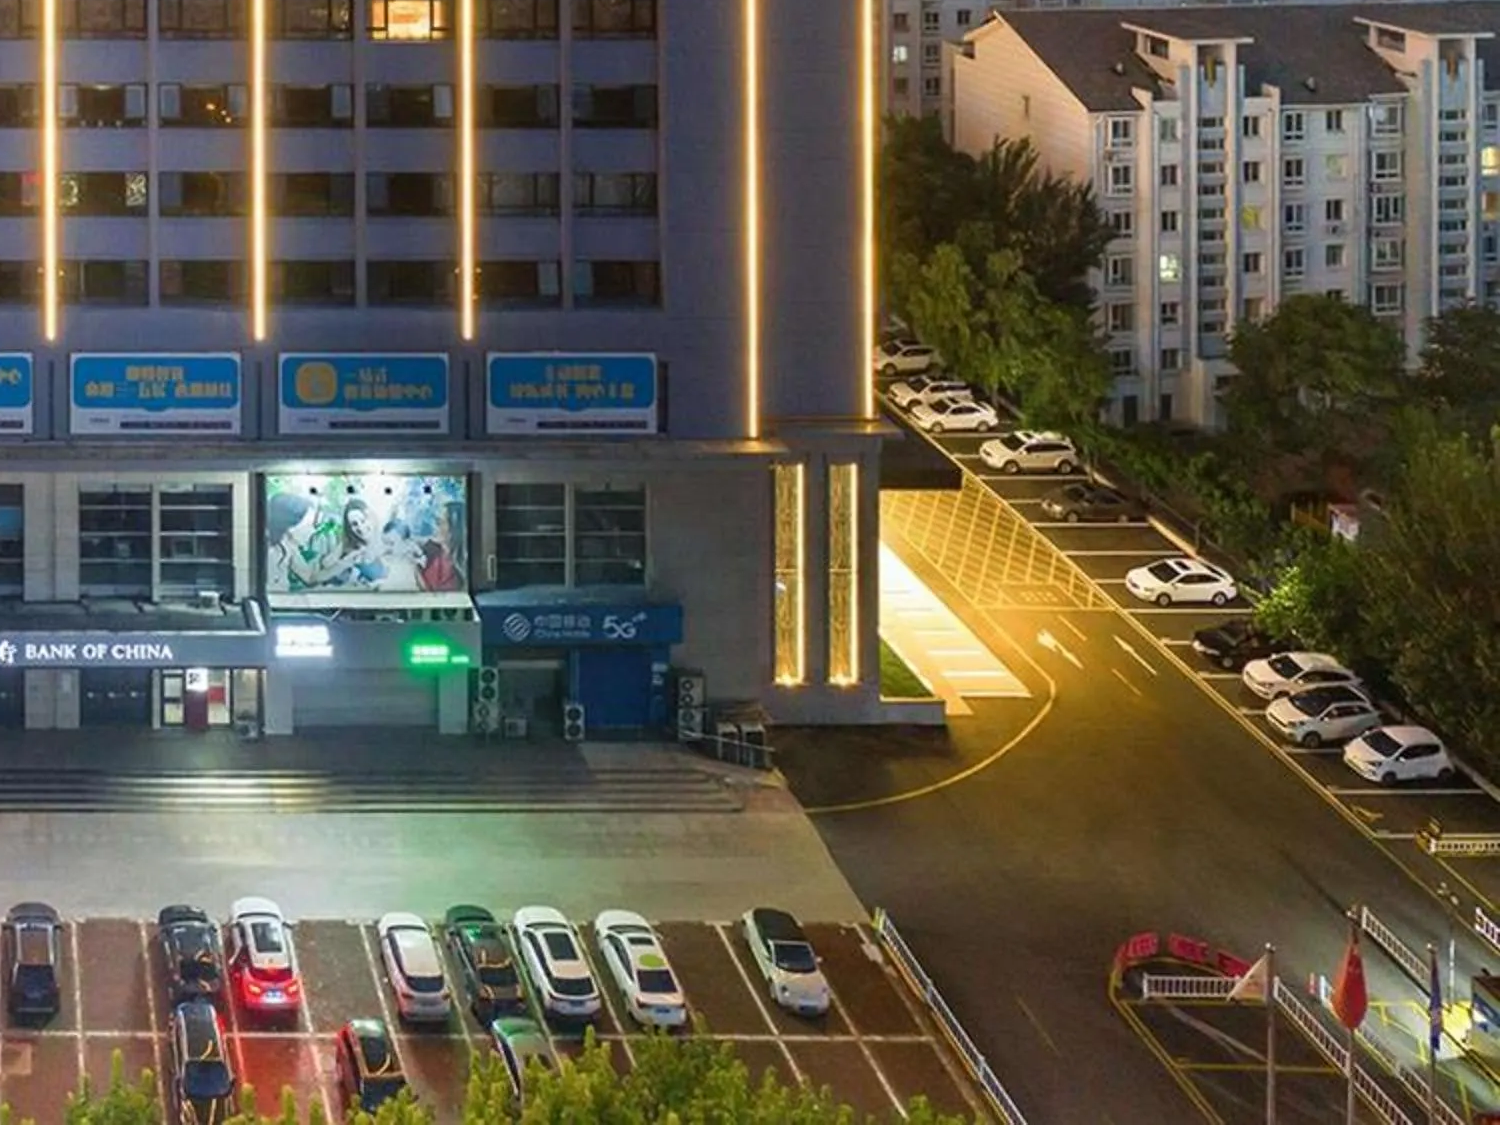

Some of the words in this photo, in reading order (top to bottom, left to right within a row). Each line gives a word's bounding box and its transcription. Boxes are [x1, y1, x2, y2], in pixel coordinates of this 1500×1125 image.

[25, 643, 77, 660] BANK
[81, 643, 108, 660] OF
[110, 643, 174, 660] CHINA
